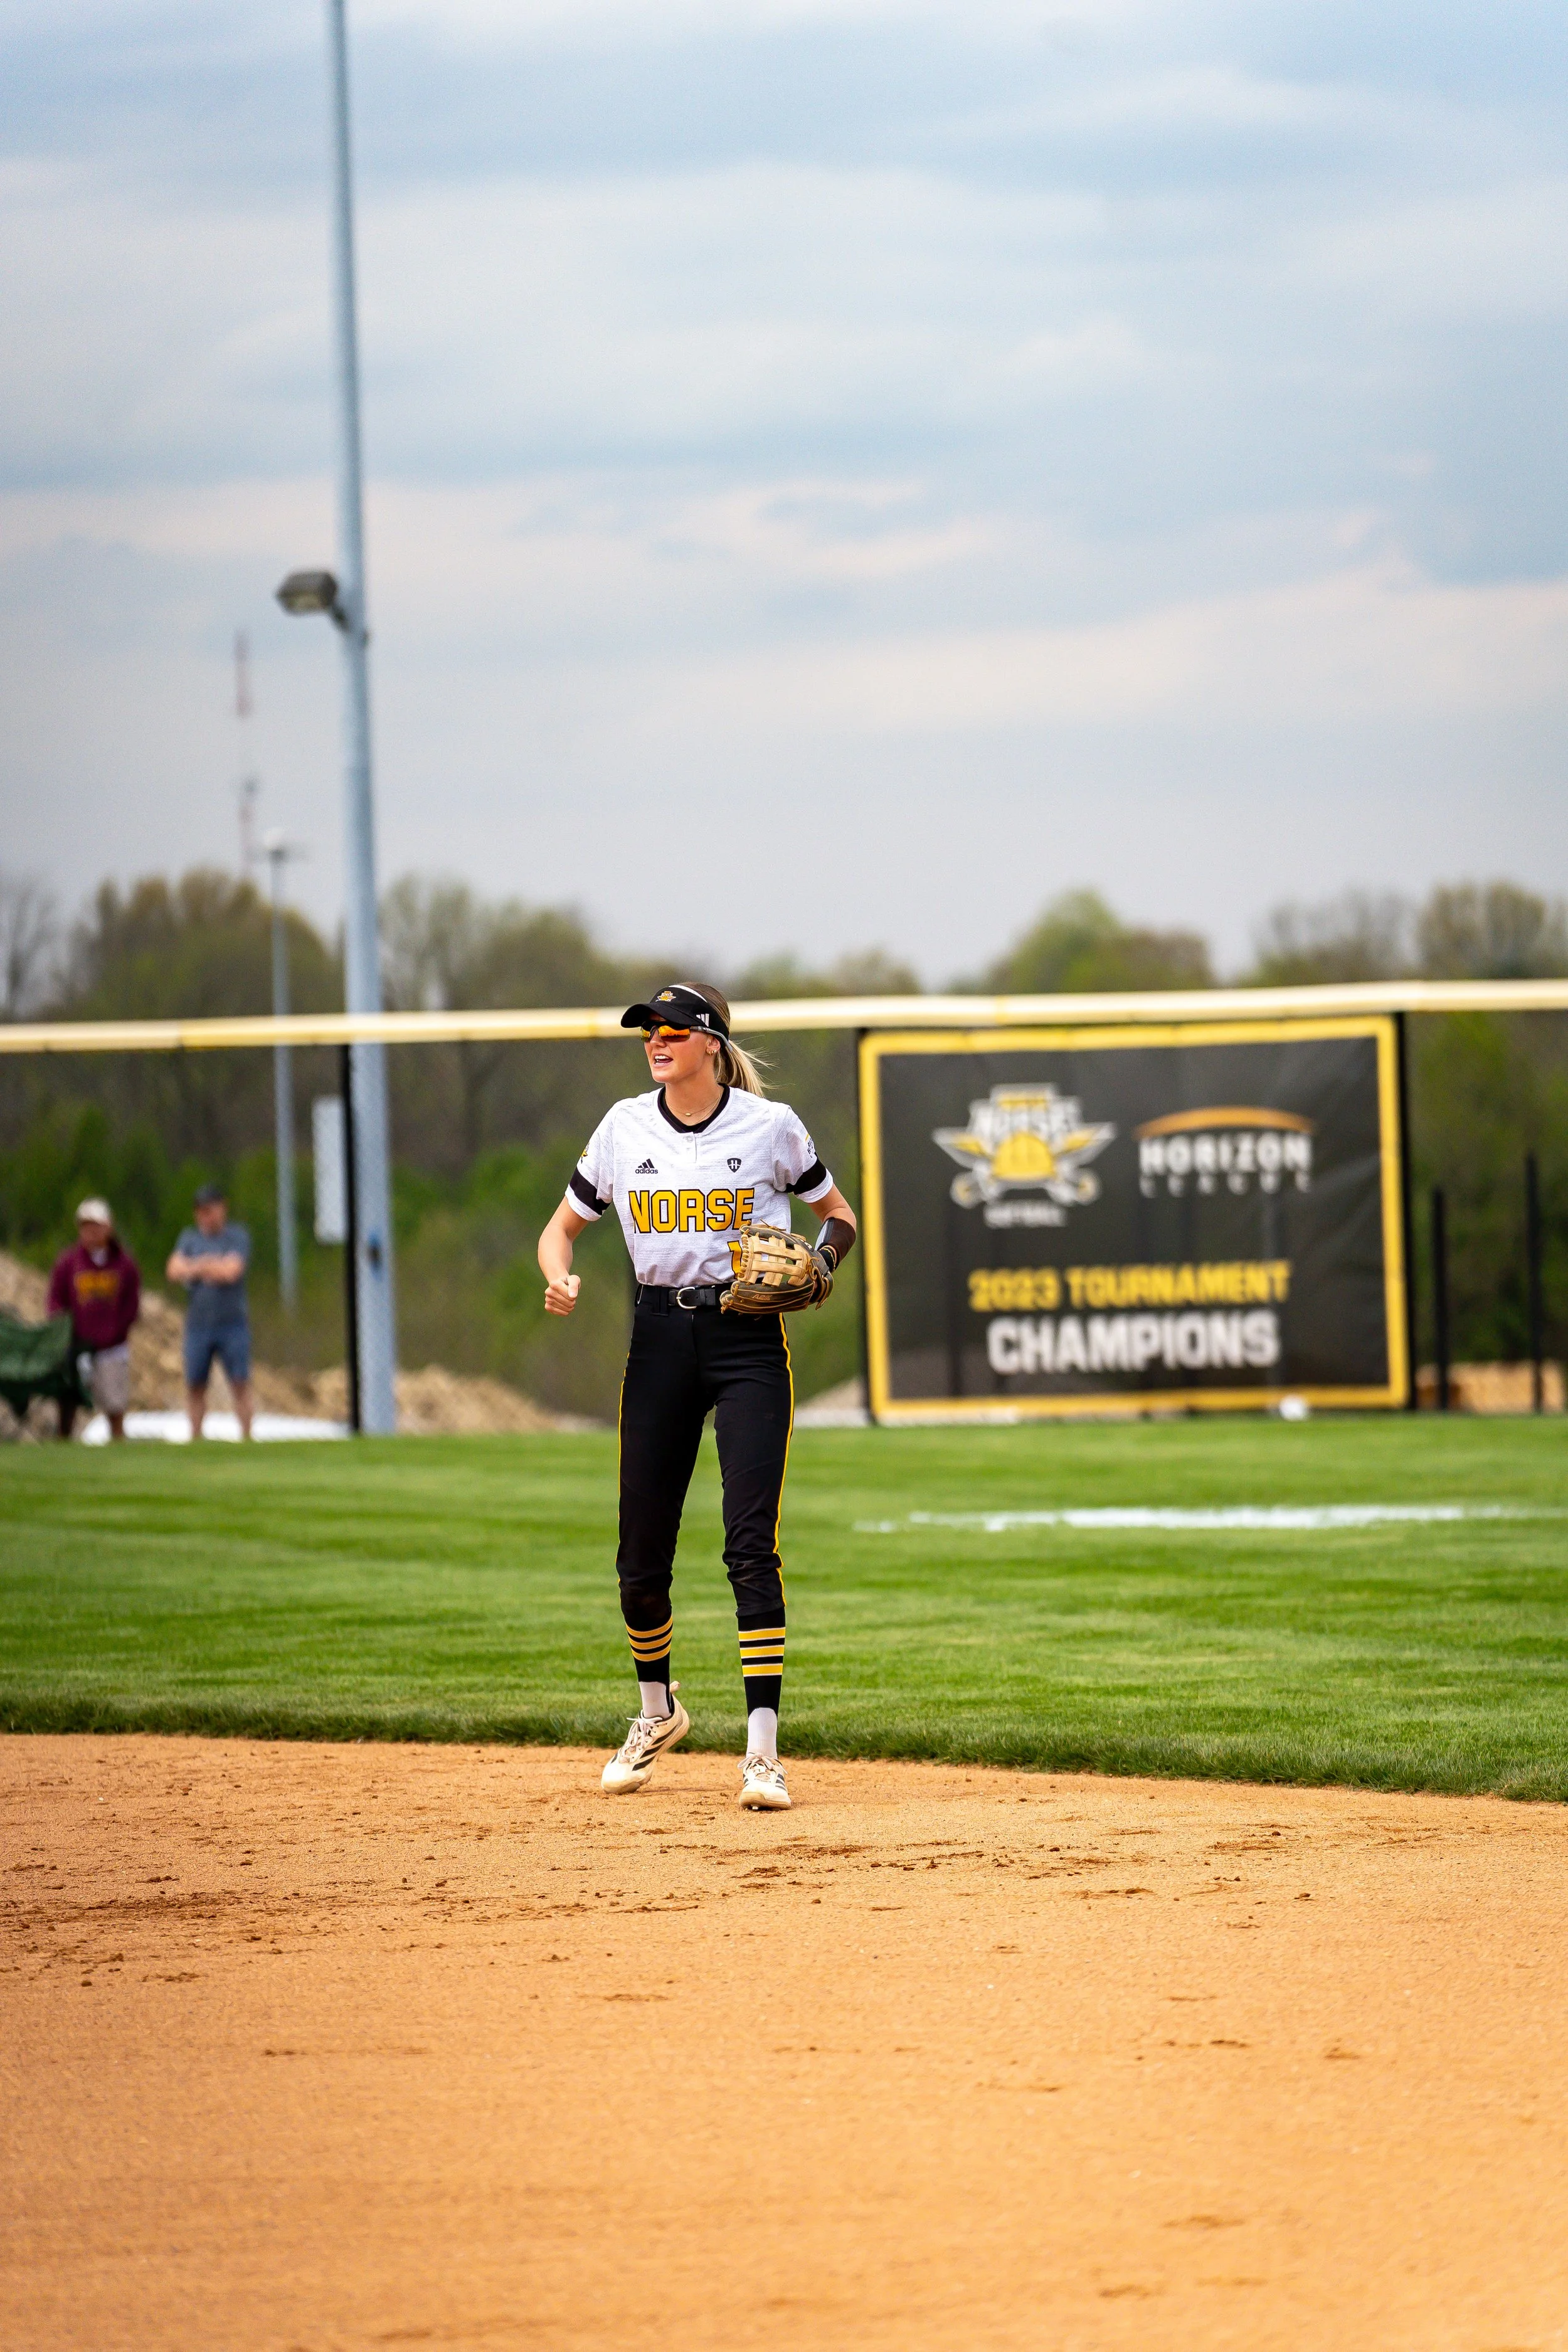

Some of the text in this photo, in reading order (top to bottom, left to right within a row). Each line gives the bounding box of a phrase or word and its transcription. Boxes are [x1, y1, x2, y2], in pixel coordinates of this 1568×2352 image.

[1139, 1133, 1311, 1175] HORIZON
[628, 1187, 755, 1234] NORSE
[968, 1260, 1290, 1311] 2023 TOURNAMENT
[987, 1310, 1279, 1374] CHAMPIONS
